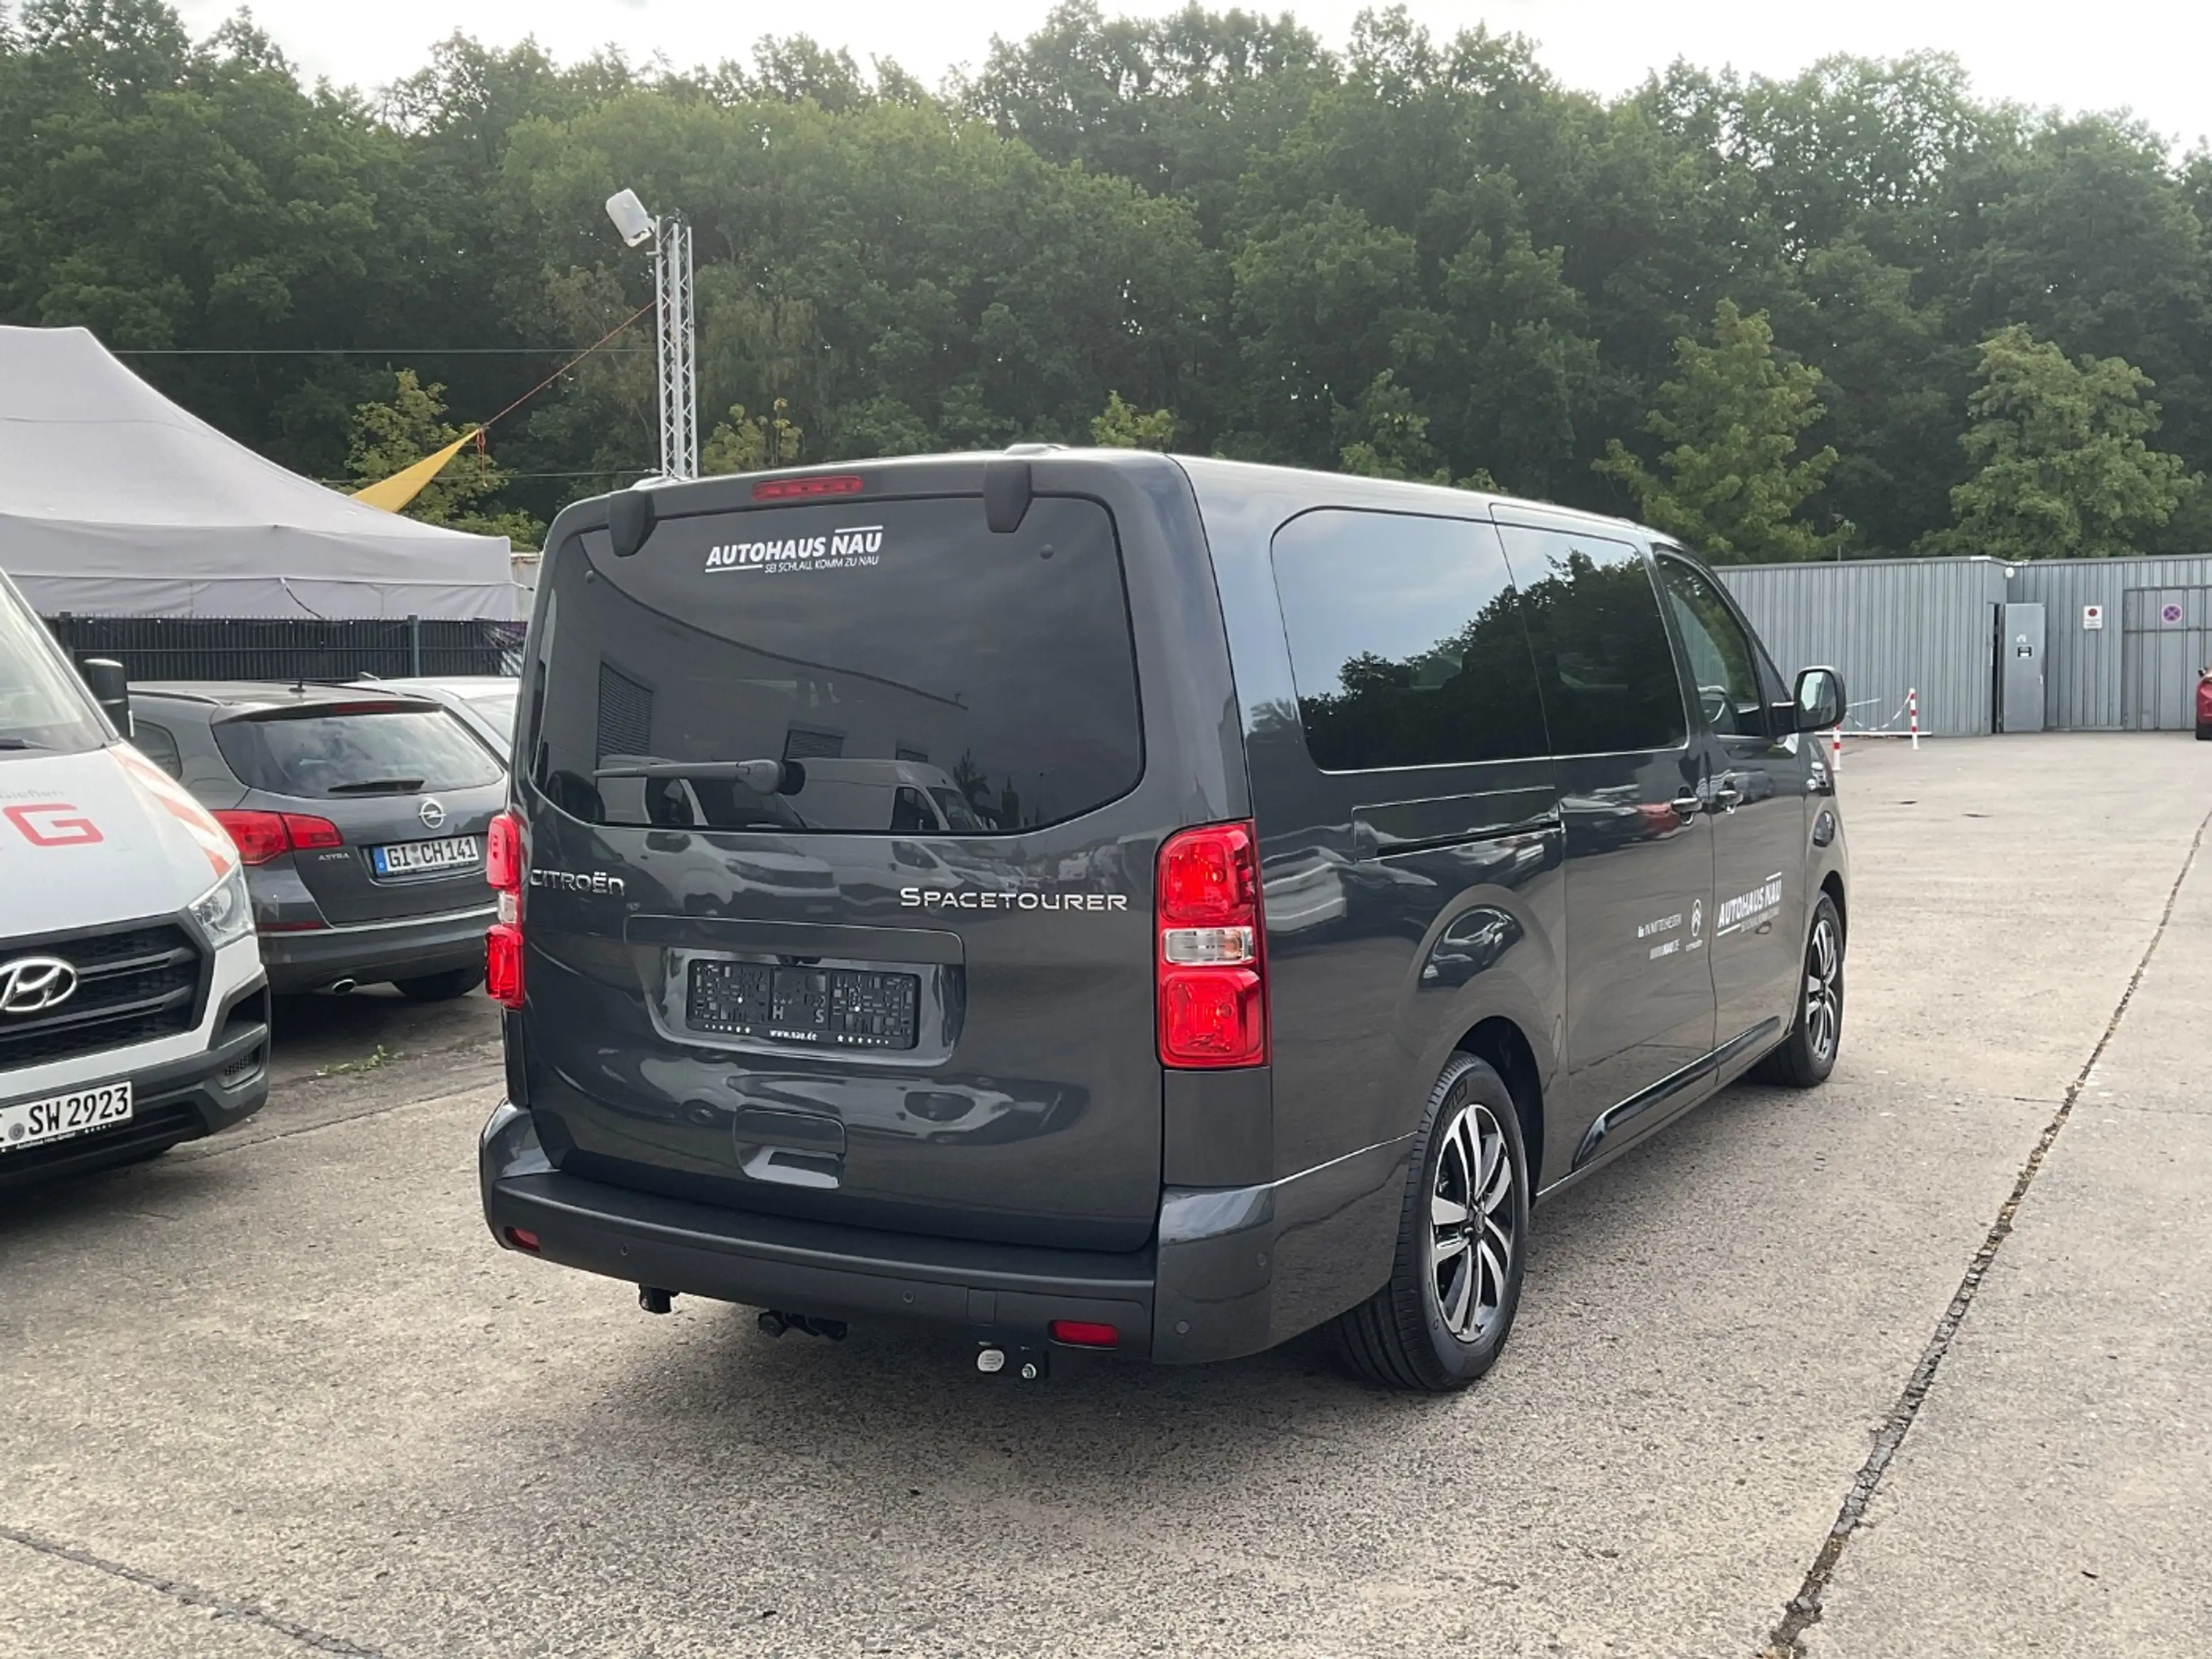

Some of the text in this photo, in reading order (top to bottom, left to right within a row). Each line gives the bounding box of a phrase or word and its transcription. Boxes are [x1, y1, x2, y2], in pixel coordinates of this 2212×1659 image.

[706, 532, 883, 566] AUTOHAUS NAU
[764, 563, 777, 574] SEI
[814, 557, 843, 569] KOMM
[844, 557, 858, 567] ZU
[858, 555, 880, 566] NAU
[387, 846, 411, 868] GI
[1717, 887, 1764, 929] AUTOHAUS
[29, 1101, 60, 1135] SW
[67, 1086, 128, 1127] 2923
